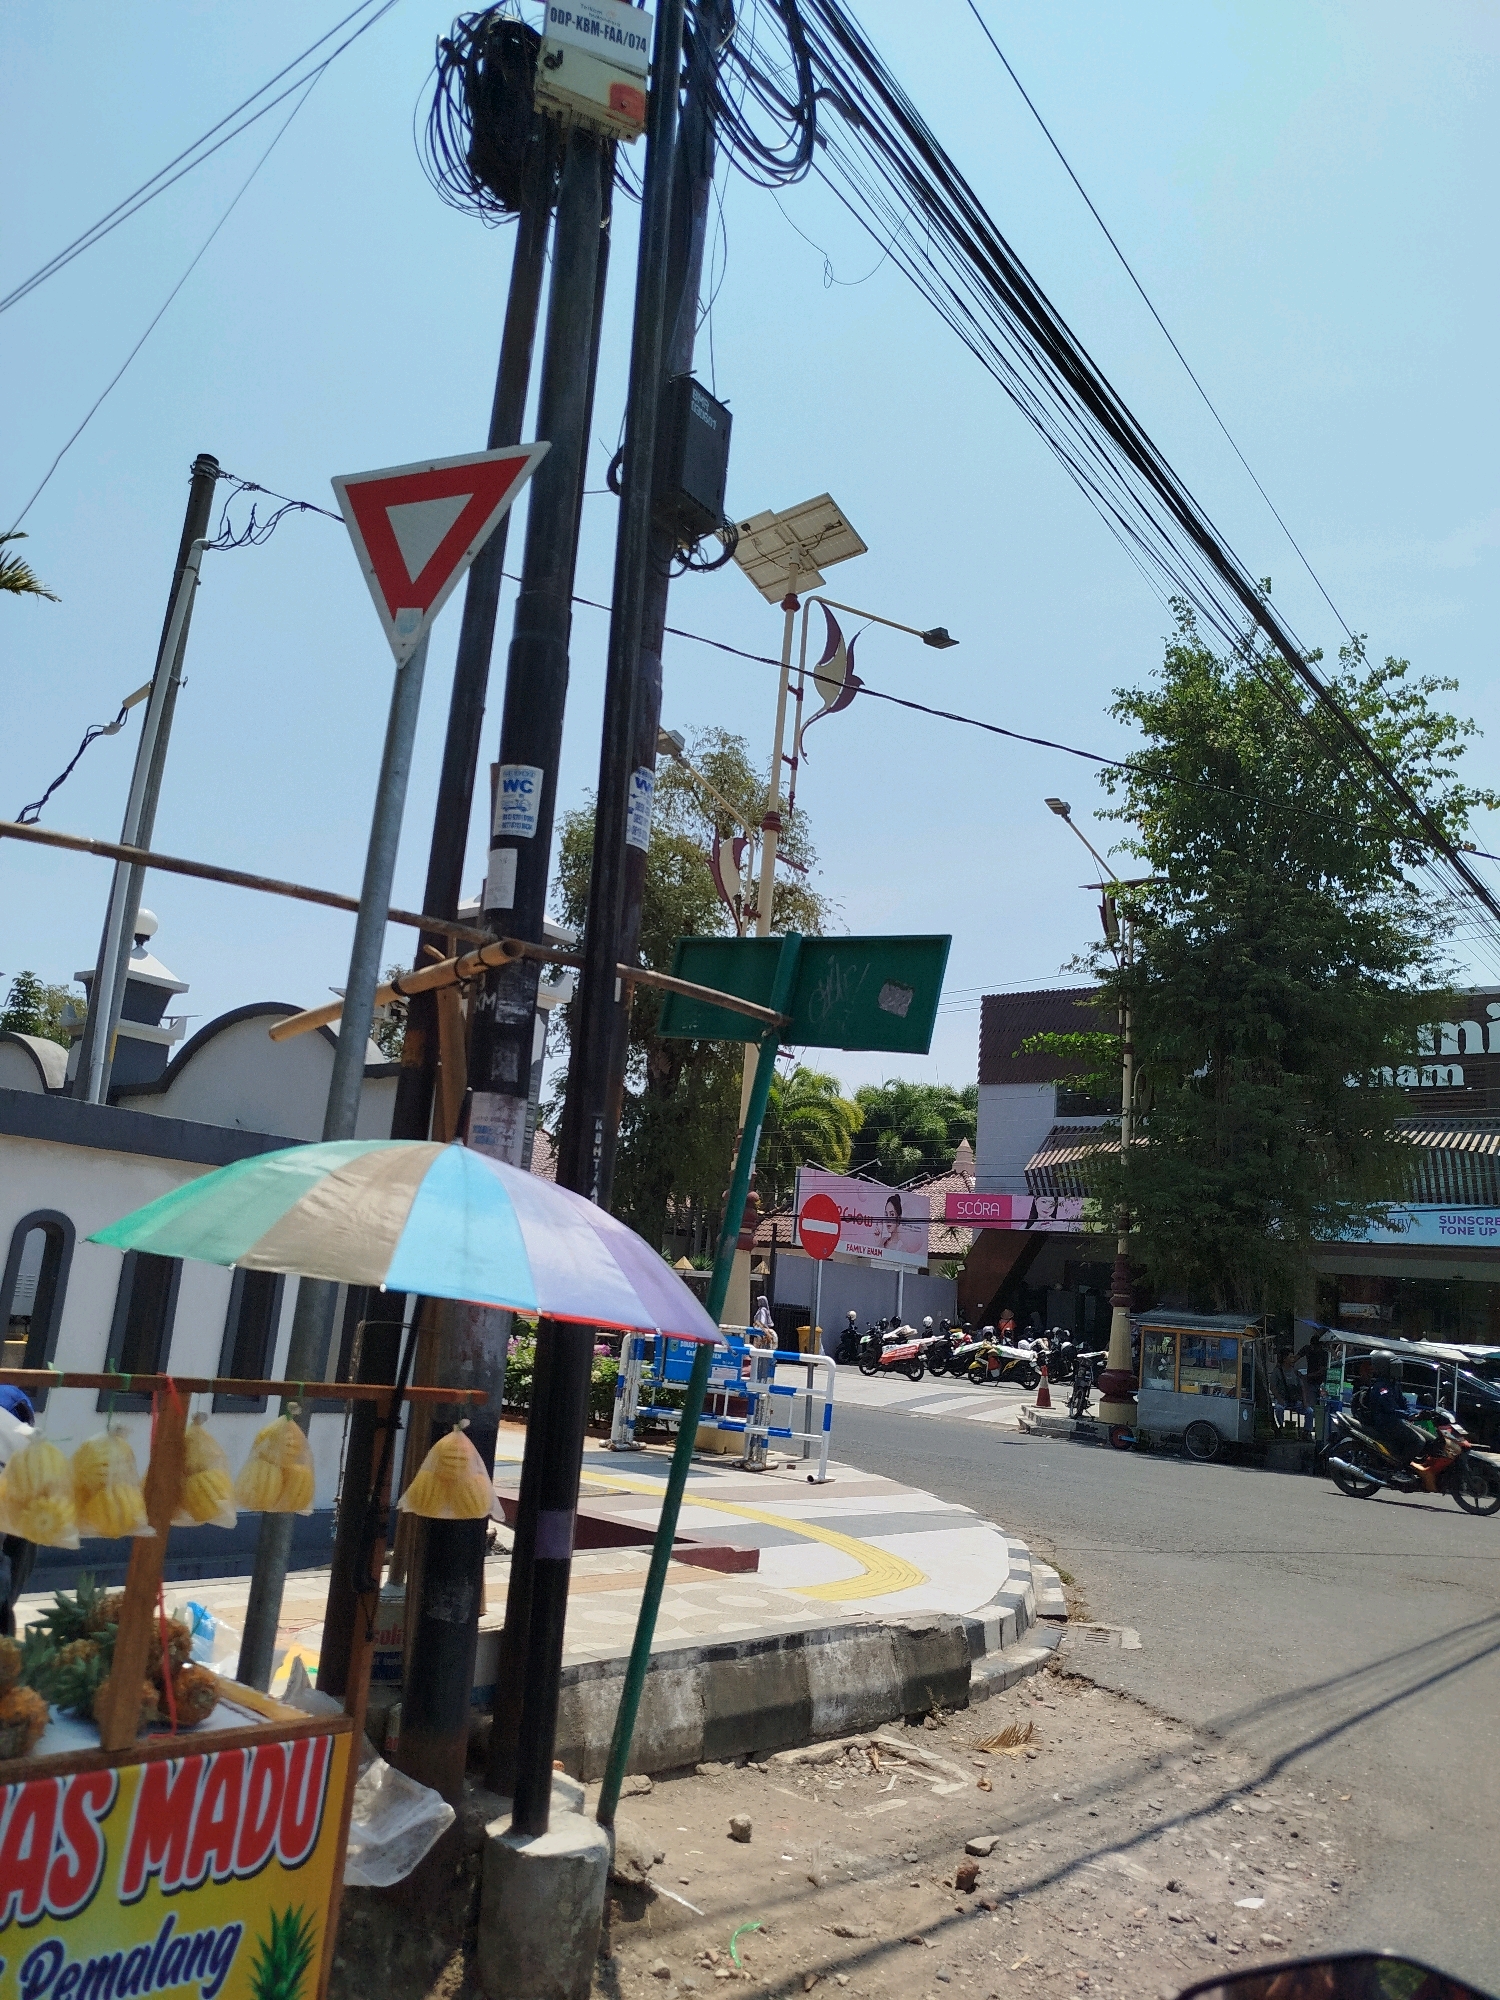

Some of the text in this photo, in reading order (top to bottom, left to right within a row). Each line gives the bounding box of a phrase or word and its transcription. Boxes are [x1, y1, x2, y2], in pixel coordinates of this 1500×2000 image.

[503, 779, 534, 793] WC
[957, 1199, 1000, 1216] SCÓRA
[1439, 1226, 1497, 1237] TONE UP
[846, 1243, 866, 1254] FAMILY
[0, 1735, 334, 1925] AS MADU
[20, 1911, 243, 2000] Pemalang
